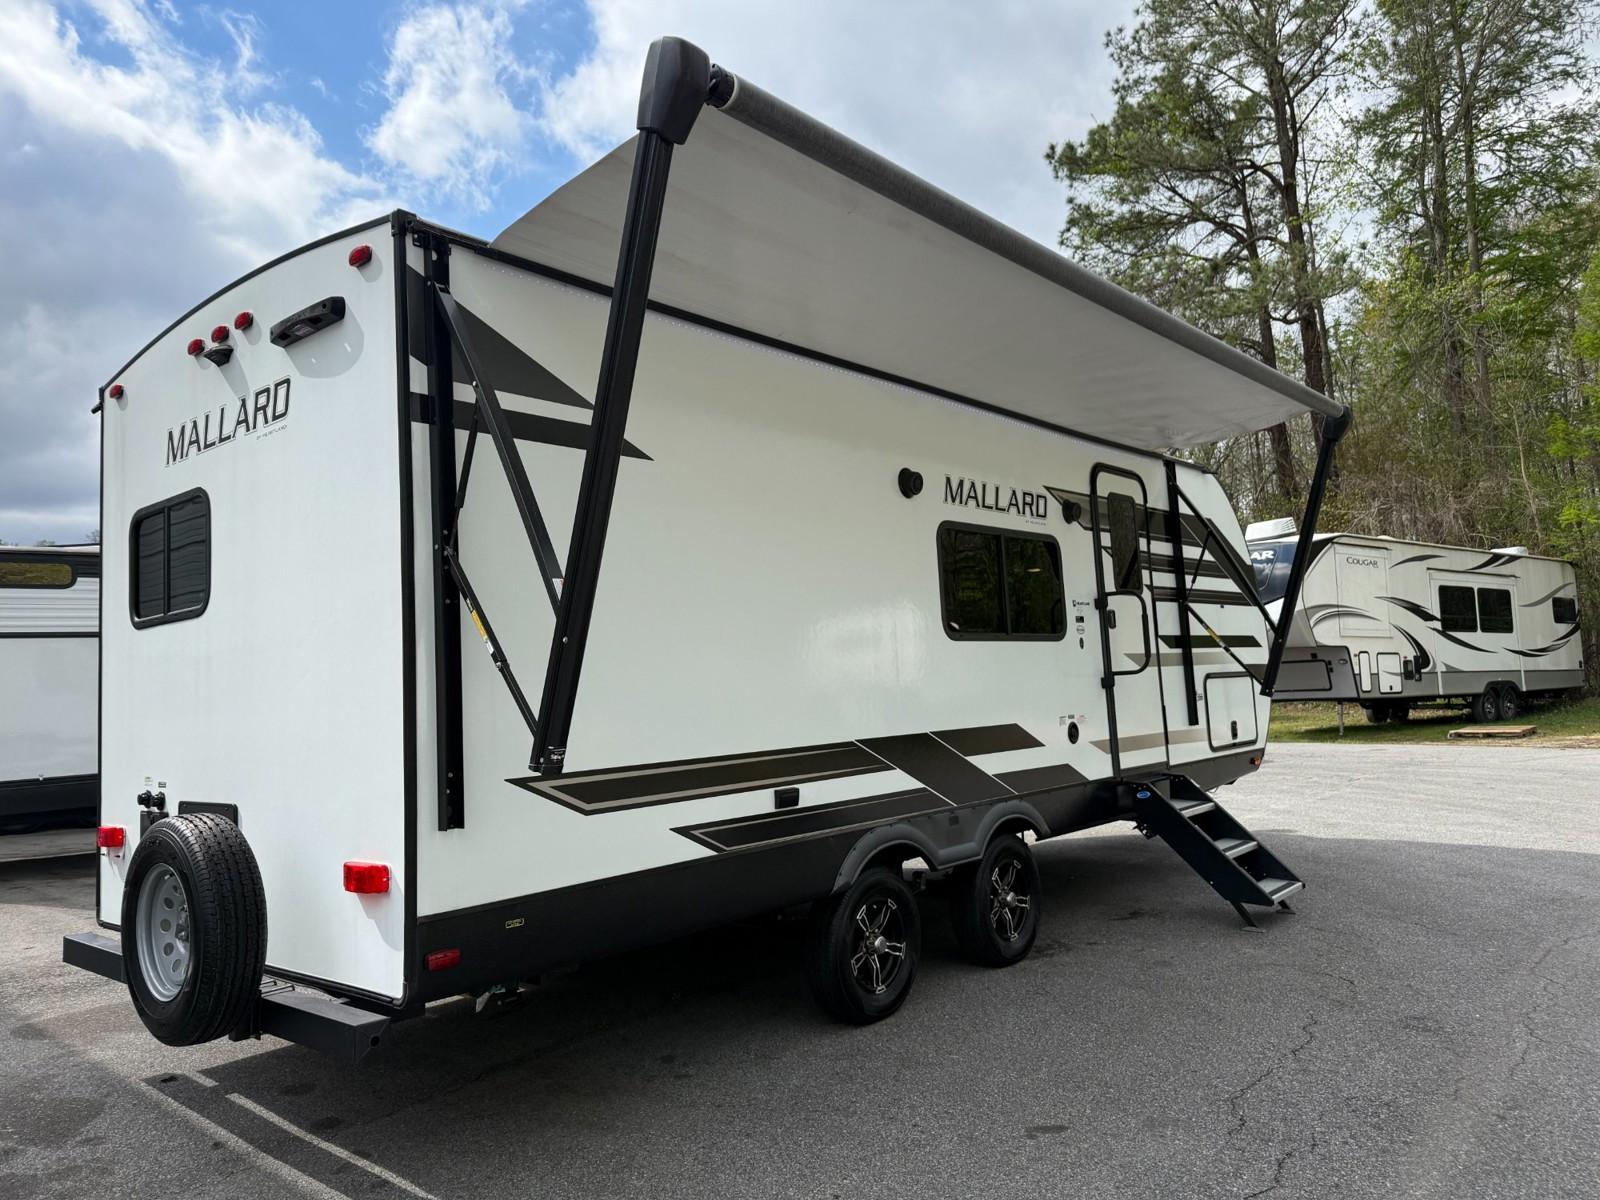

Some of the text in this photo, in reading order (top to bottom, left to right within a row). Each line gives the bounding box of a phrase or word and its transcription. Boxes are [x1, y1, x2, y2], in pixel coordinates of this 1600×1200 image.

[165, 376, 291, 467] MALLARD
[943, 475, 1048, 519] MALLARD
[1346, 556, 1379, 569] COUGAR
